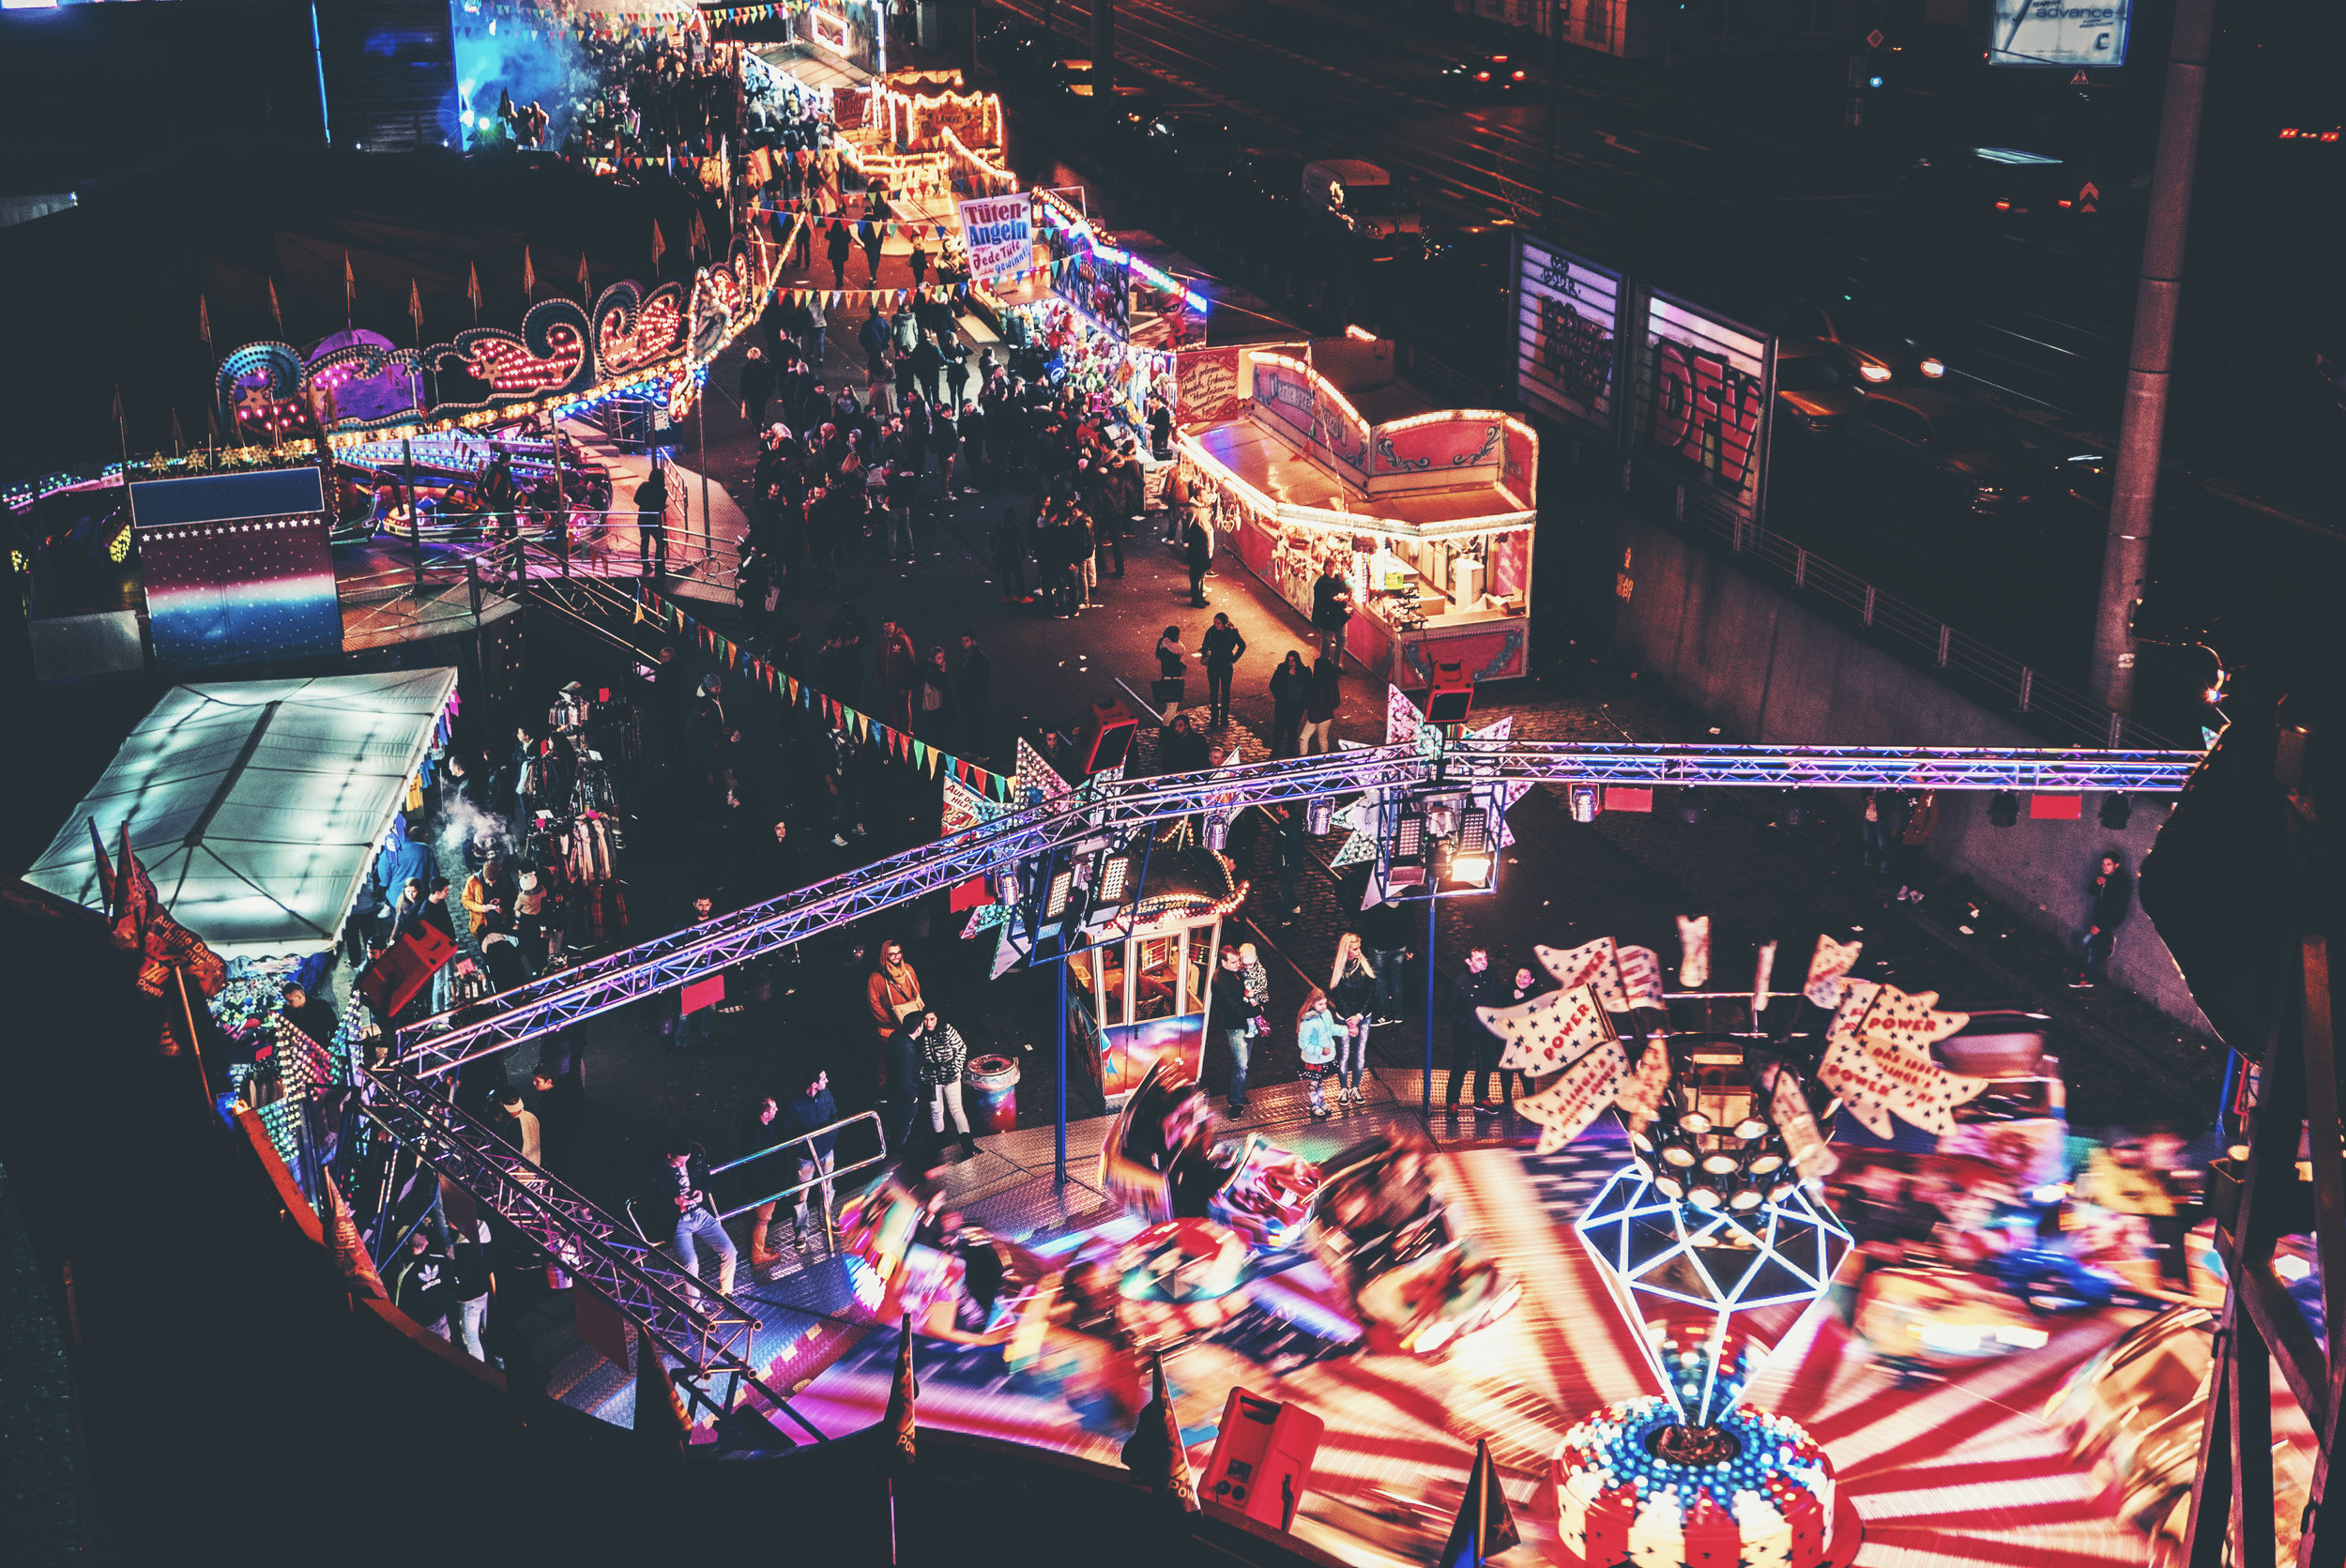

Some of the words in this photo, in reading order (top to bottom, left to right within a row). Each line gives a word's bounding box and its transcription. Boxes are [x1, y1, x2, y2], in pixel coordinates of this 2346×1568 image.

[2035, 7, 2114, 19] advance
[965, 202, 1028, 225] Tüten-
[967, 220, 1028, 247] Angeln
[972, 251, 1000, 270] Jede
[1000, 240, 1021, 258] Tüte
[995, 245, 1030, 274] gewinnt!
[945, 784, 964, 799] AUF
[951, 797, 973, 812] HILFT
[1136, 904, 1159, 915] REAK
[1164, 900, 1190, 909] DANCE
[154, 915, 174, 932] Auf
[175, 927, 192, 945] die
[192, 941, 224, 970] Dauer
[184, 949, 205, 967] nur
[136, 978, 165, 997] Power
[1543, 1003, 1590, 1061] POWER
[1867, 1016, 1937, 1032] POWER
